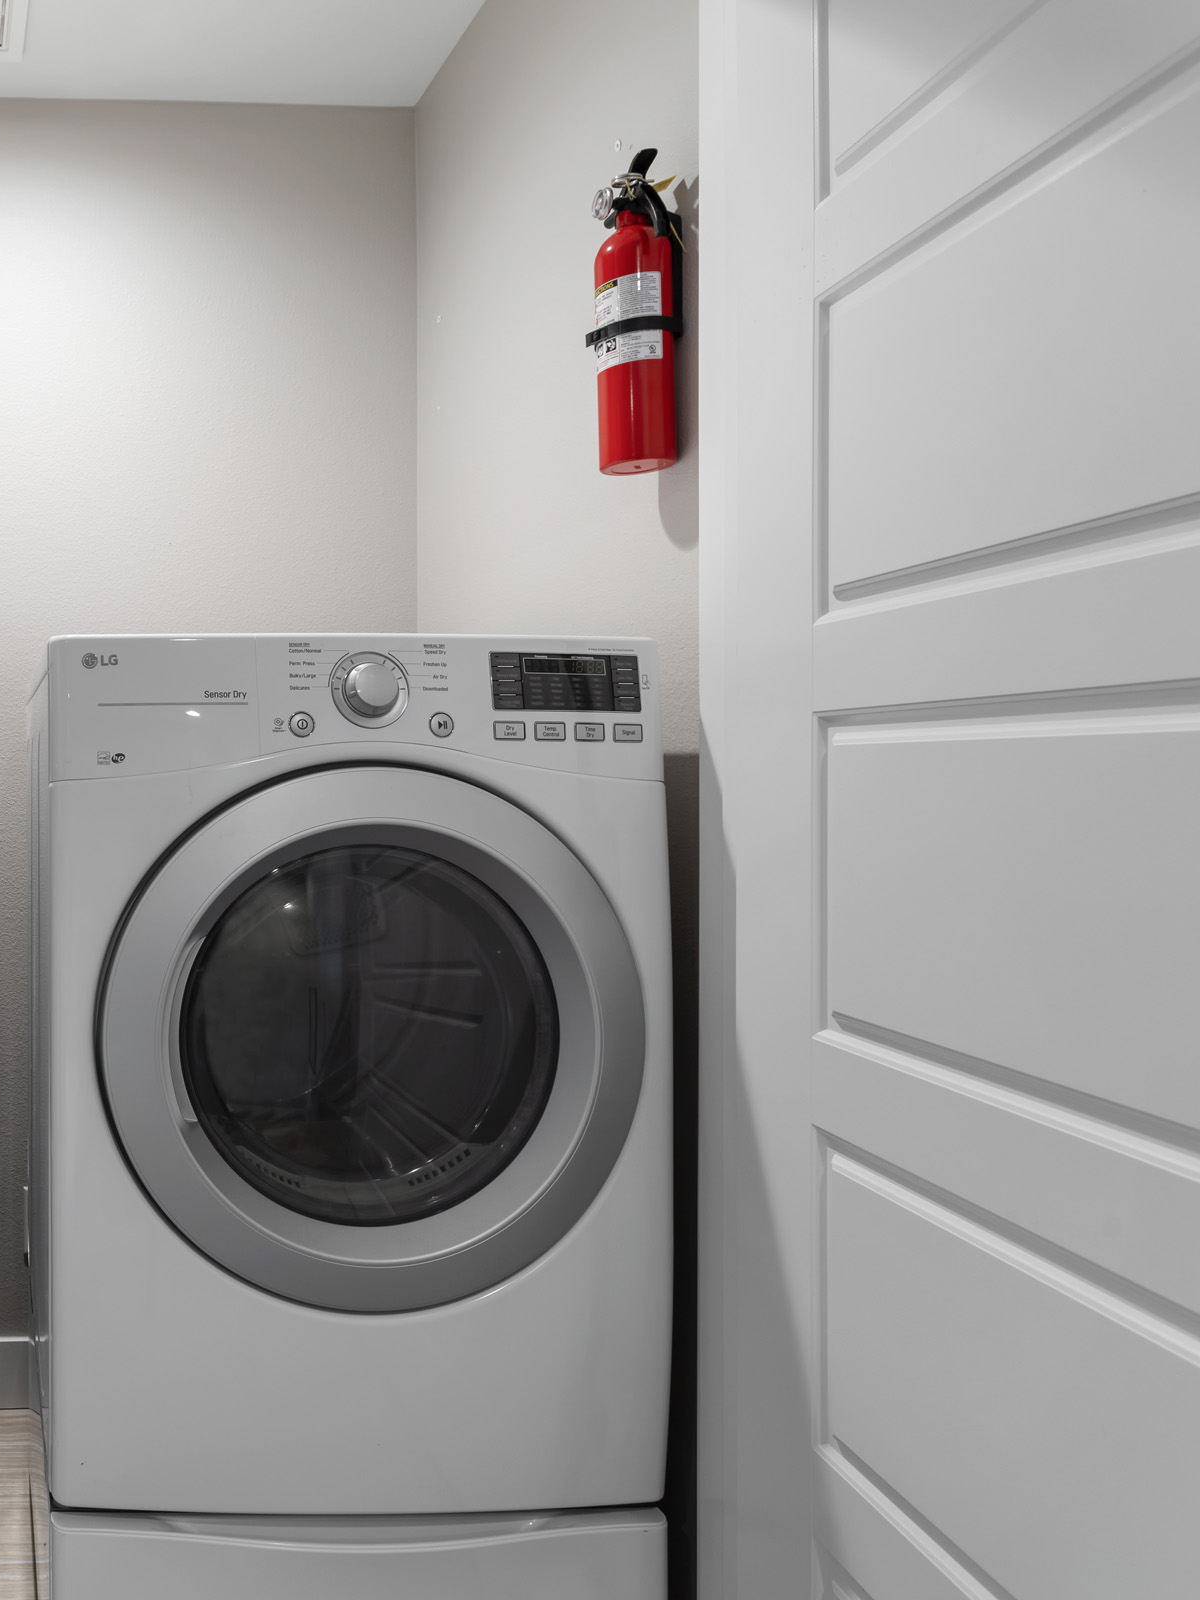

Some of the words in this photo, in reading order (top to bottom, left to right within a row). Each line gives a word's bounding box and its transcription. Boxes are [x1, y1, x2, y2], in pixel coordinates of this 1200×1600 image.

[100, 654, 119, 666] LG
[204, 690, 231, 699] Sensor
[233, 690, 247, 700] Dry
